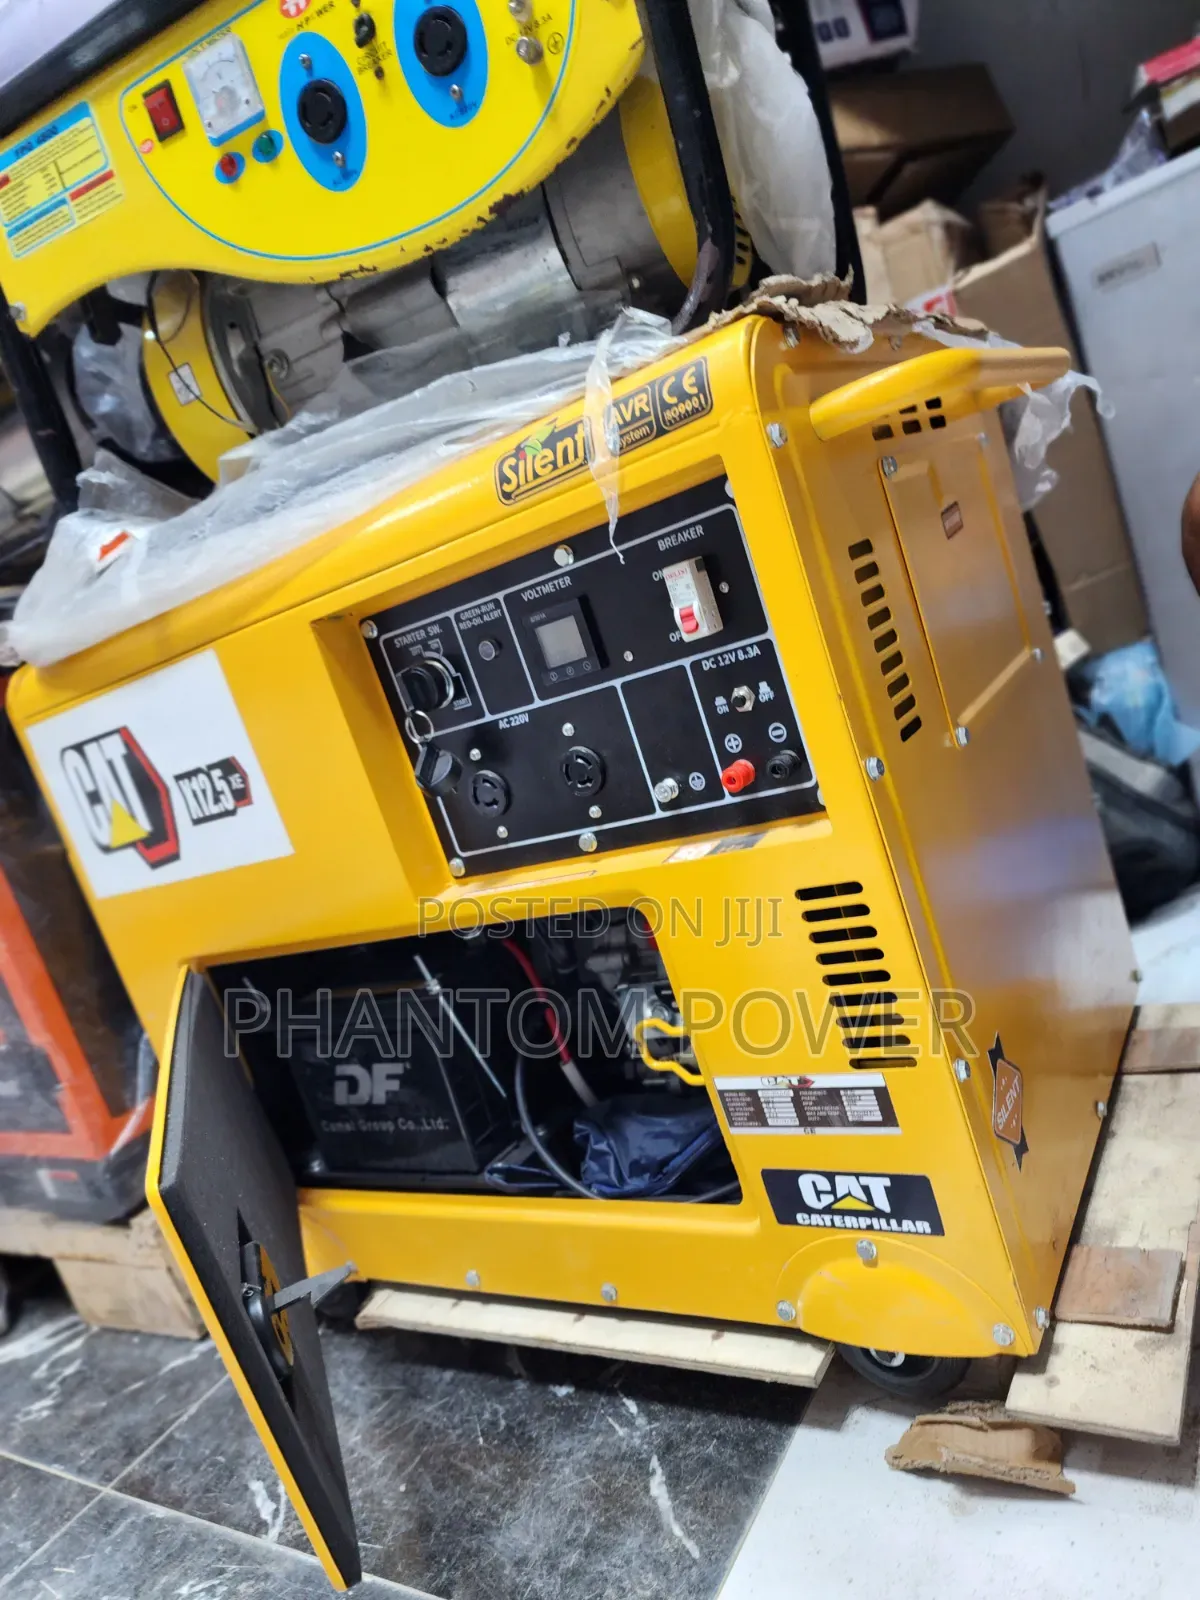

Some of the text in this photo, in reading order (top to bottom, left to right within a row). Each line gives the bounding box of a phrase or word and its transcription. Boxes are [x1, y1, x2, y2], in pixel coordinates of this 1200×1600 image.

[608, 392, 650, 427] AVR
[618, 424, 650, 450] ystem
[501, 422, 587, 493] Silent
[657, 525, 704, 551] BREAKER
[521, 576, 572, 602] VOLTMETER
[459, 609, 503, 631] RED-OIL ALERT
[460, 602, 495, 621] GREEN-RUN
[393, 623, 443, 648] STARTER SW.
[701, 644, 761, 671] DC 12V 8.3A
[453, 697, 470, 708] START
[758, 689, 775, 703] OFF
[498, 712, 530, 729] AC 220V
[716, 704, 730, 715] ON
[62, 731, 153, 848] CAT
[333, 1062, 405, 1106] DF
[996, 1074, 1020, 1130] SILENT
[357, 1118, 395, 1134] Group
[797, 1172, 892, 1214] CAT
[795, 1212, 932, 1235] CATERPILLAR
